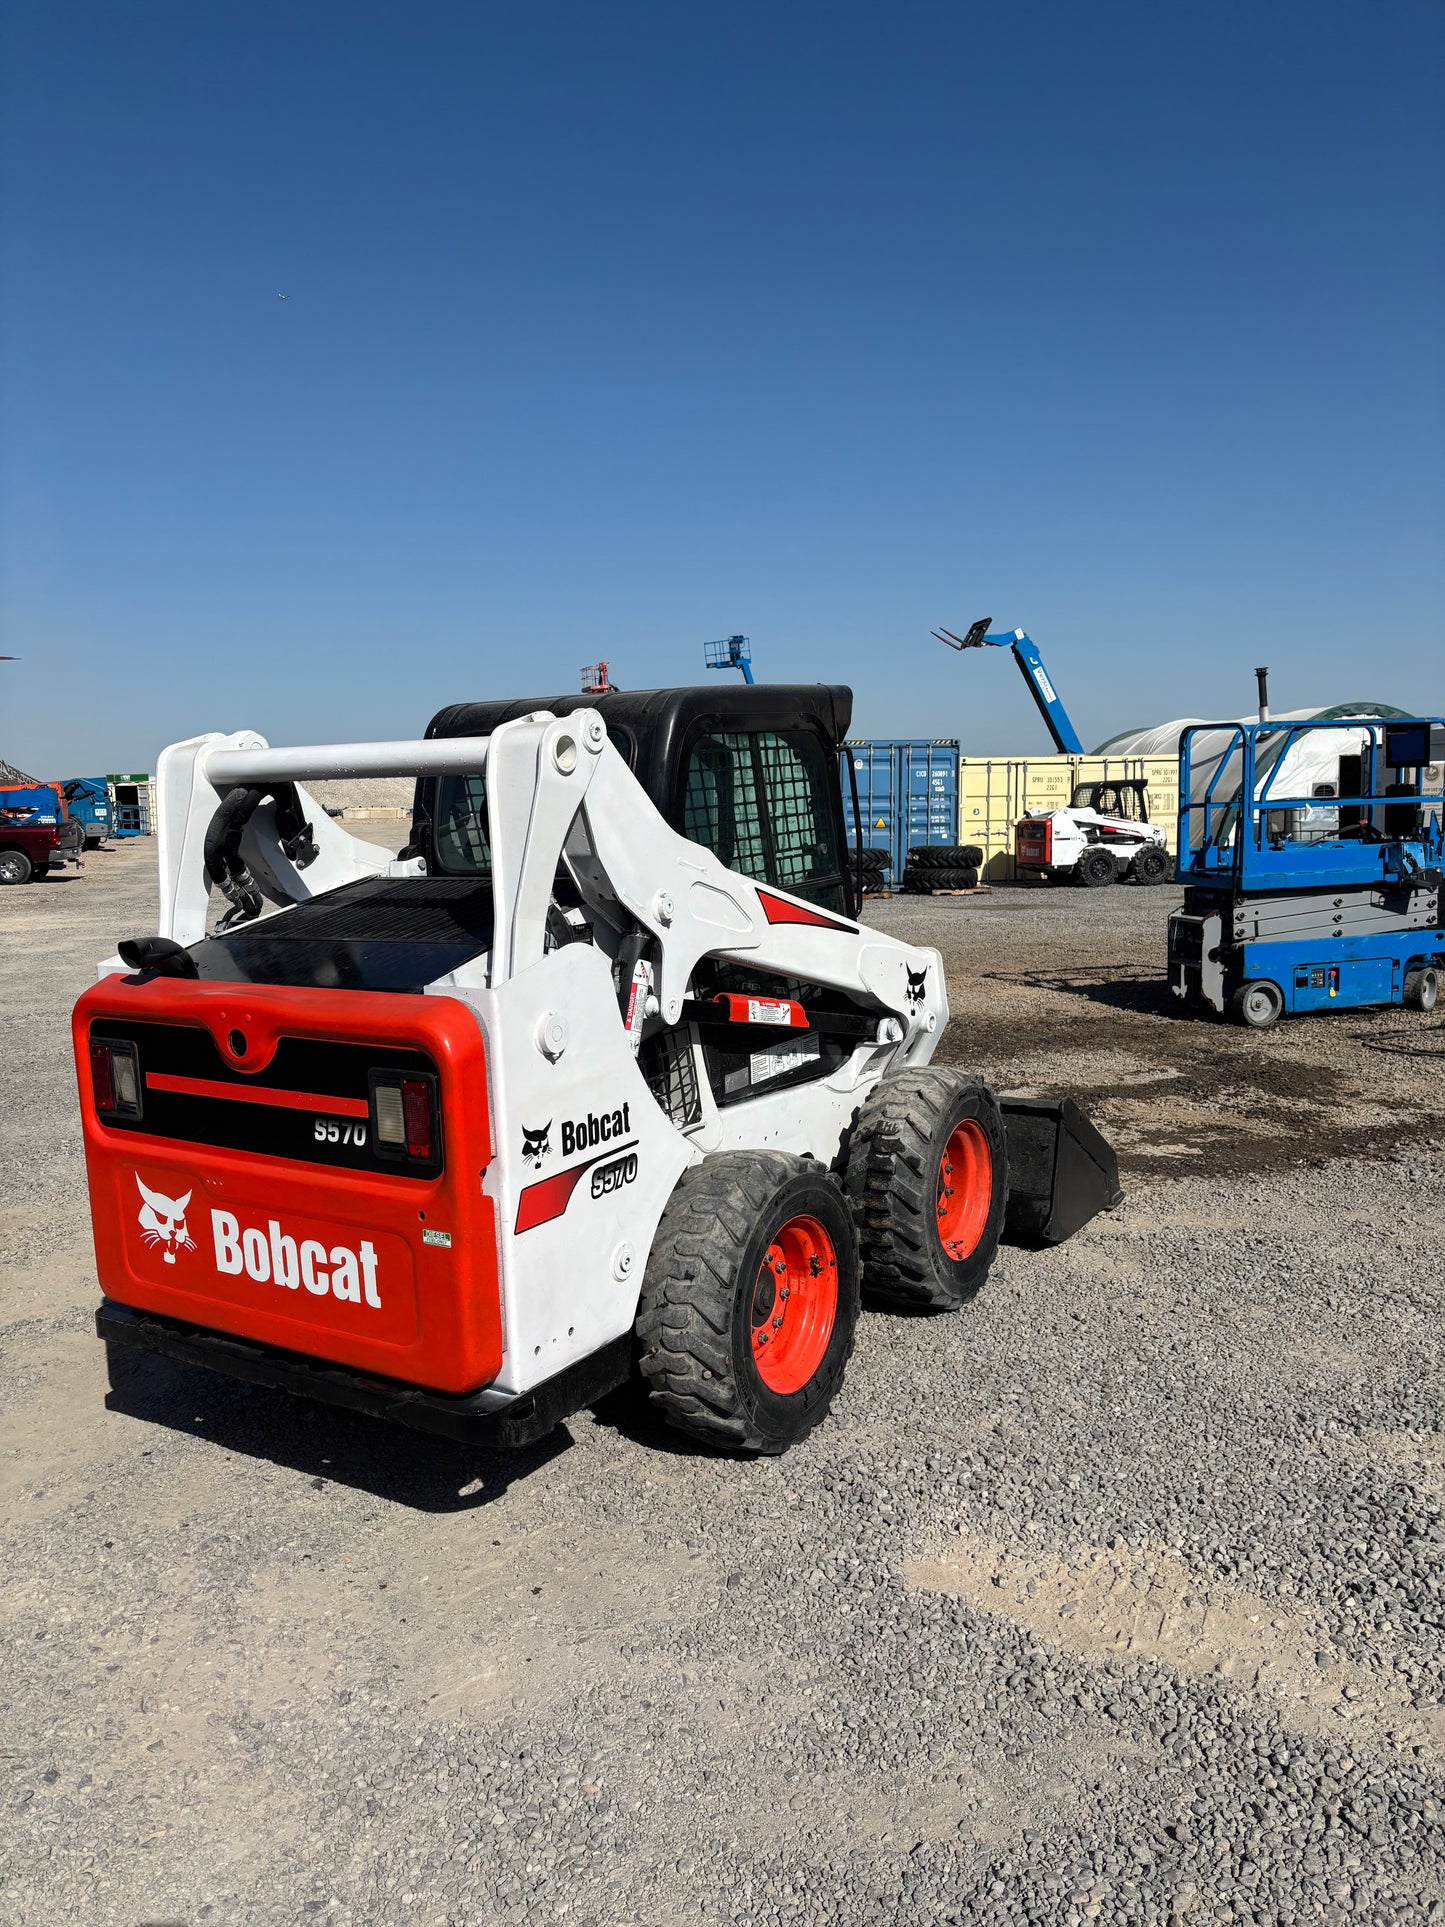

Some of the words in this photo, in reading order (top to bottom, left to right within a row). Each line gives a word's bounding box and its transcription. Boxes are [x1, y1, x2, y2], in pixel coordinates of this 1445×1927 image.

[627, 992, 635, 1016] DANGER
[314, 1118, 366, 1146] S570
[561, 1101, 630, 1157] Bobcat
[591, 1152, 638, 1200] S570
[426, 1231, 446, 1240] DIESEL
[210, 1208, 382, 1309] Bobcat
